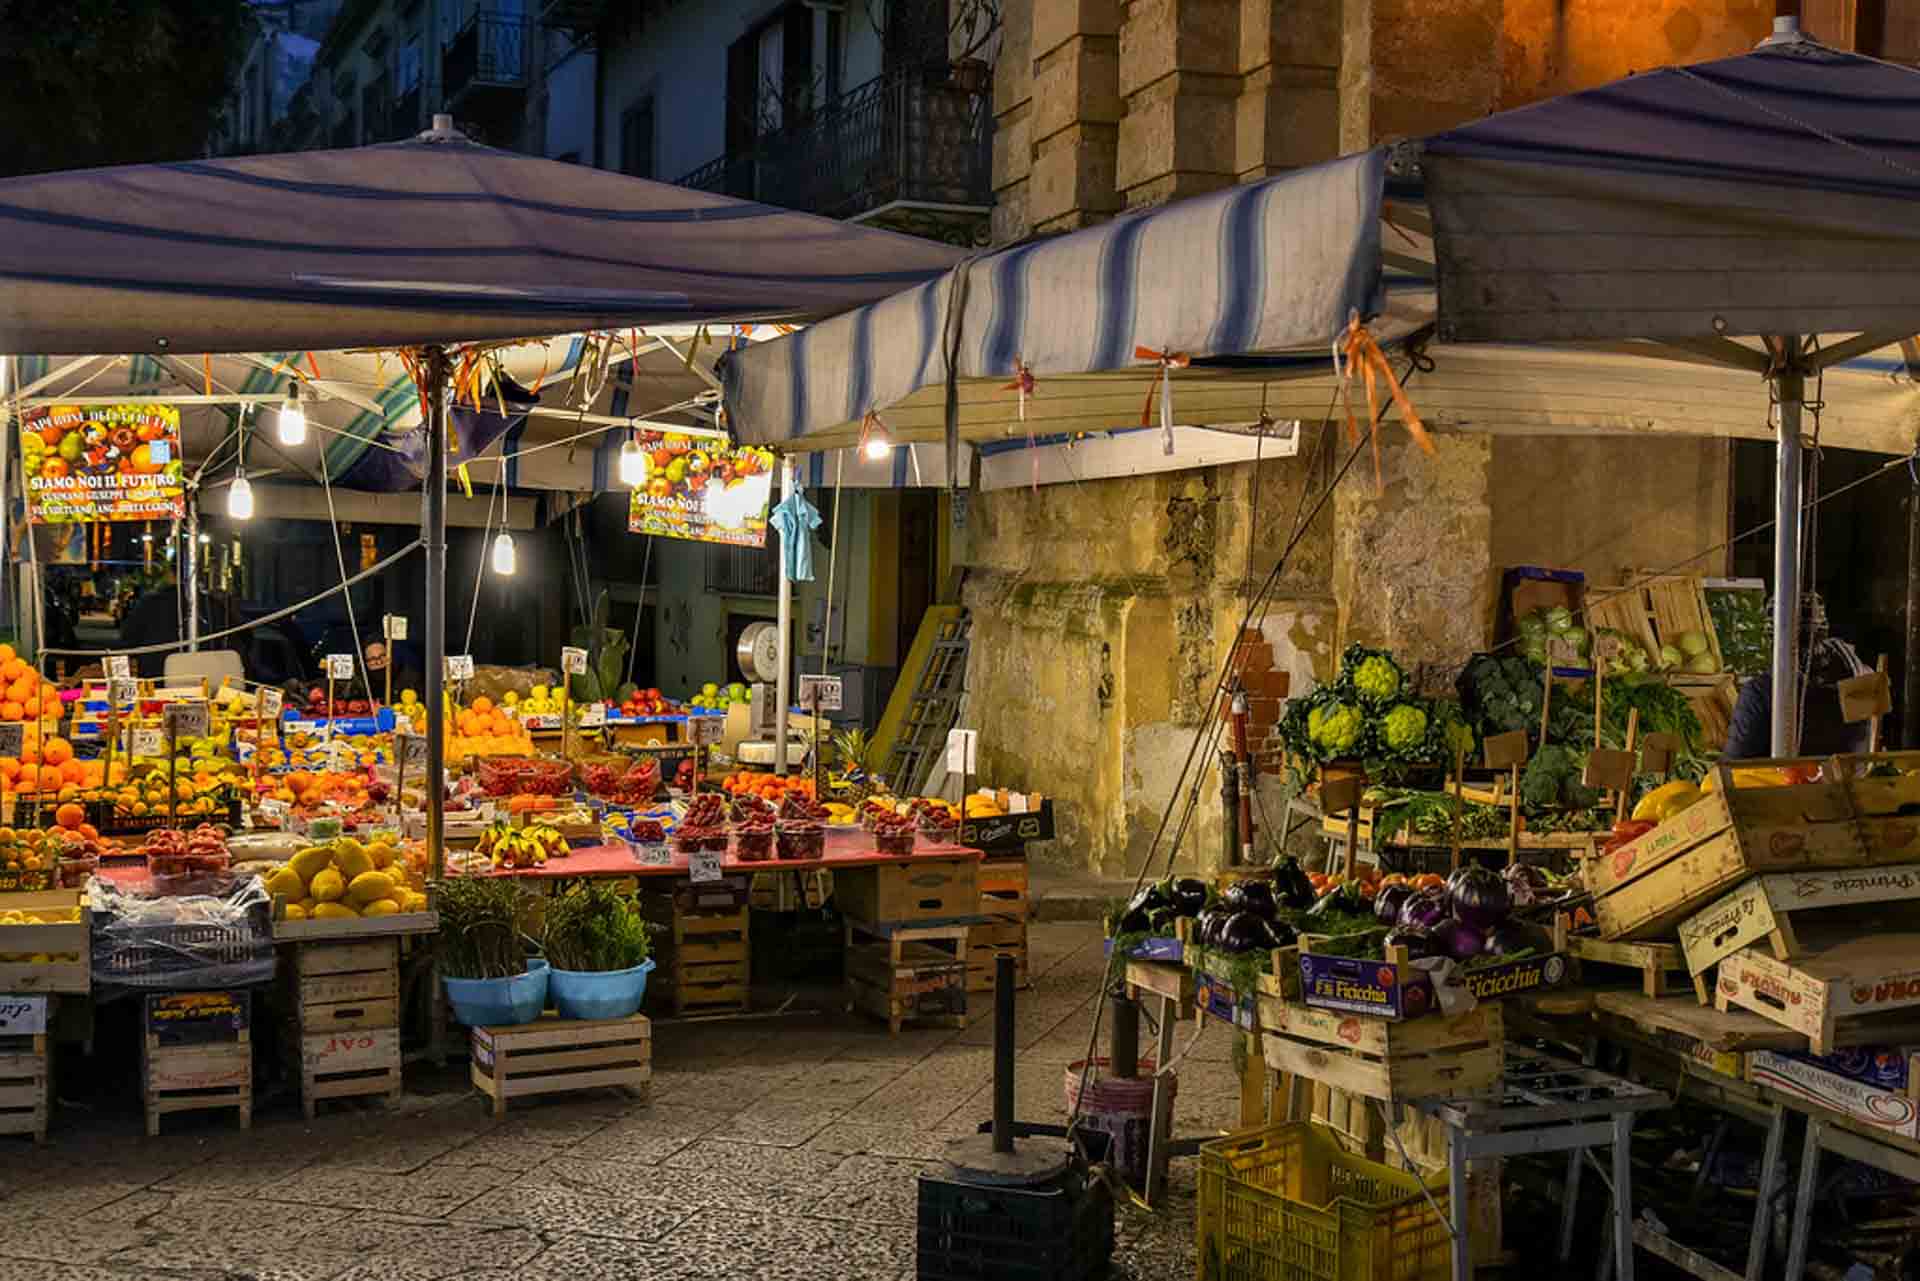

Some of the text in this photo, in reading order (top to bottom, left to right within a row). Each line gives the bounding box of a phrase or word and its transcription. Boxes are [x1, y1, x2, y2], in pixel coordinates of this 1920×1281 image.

[31, 472, 176, 490] SIAMO NOI IL FUTURO
[637, 492, 675, 506] SIAMO
